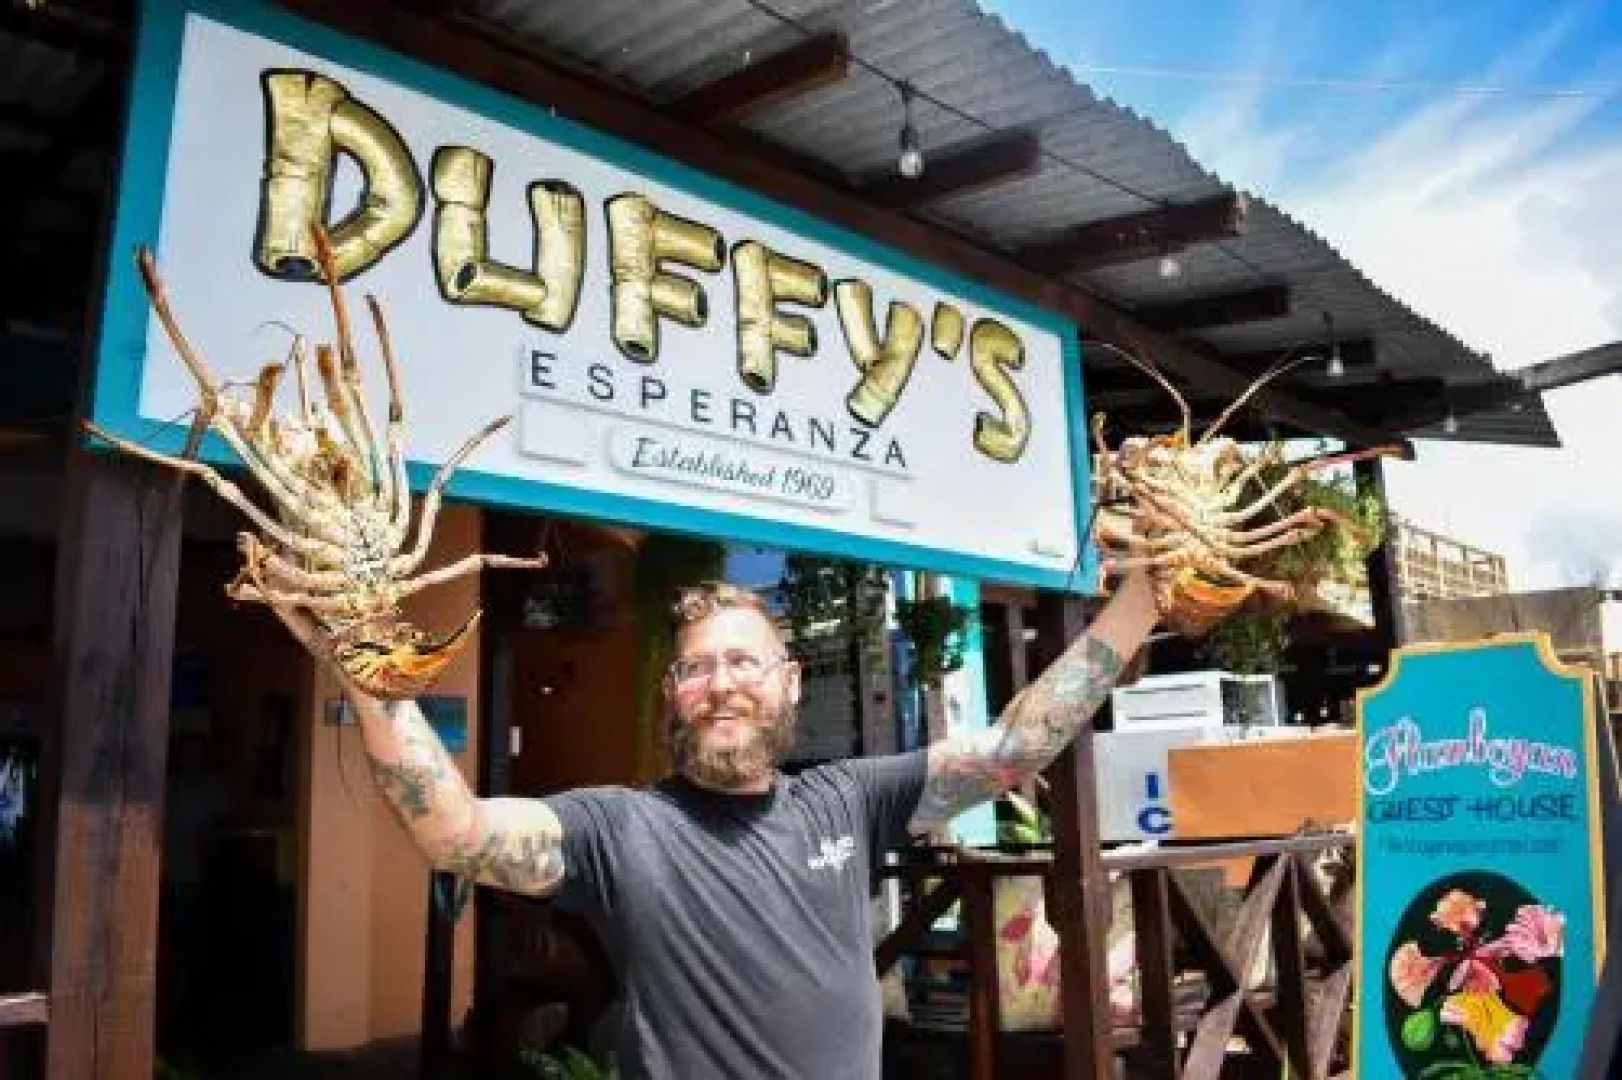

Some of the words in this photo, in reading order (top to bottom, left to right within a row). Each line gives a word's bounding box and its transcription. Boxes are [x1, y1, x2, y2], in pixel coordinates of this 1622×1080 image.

[252, 67, 1033, 463] DUFFY'S
[530, 349, 908, 468] ESPERANZA
[632, 437, 776, 487] Established
[1368, 796, 1459, 823] GUEST
[1466, 794, 1580, 821] HOUSE
